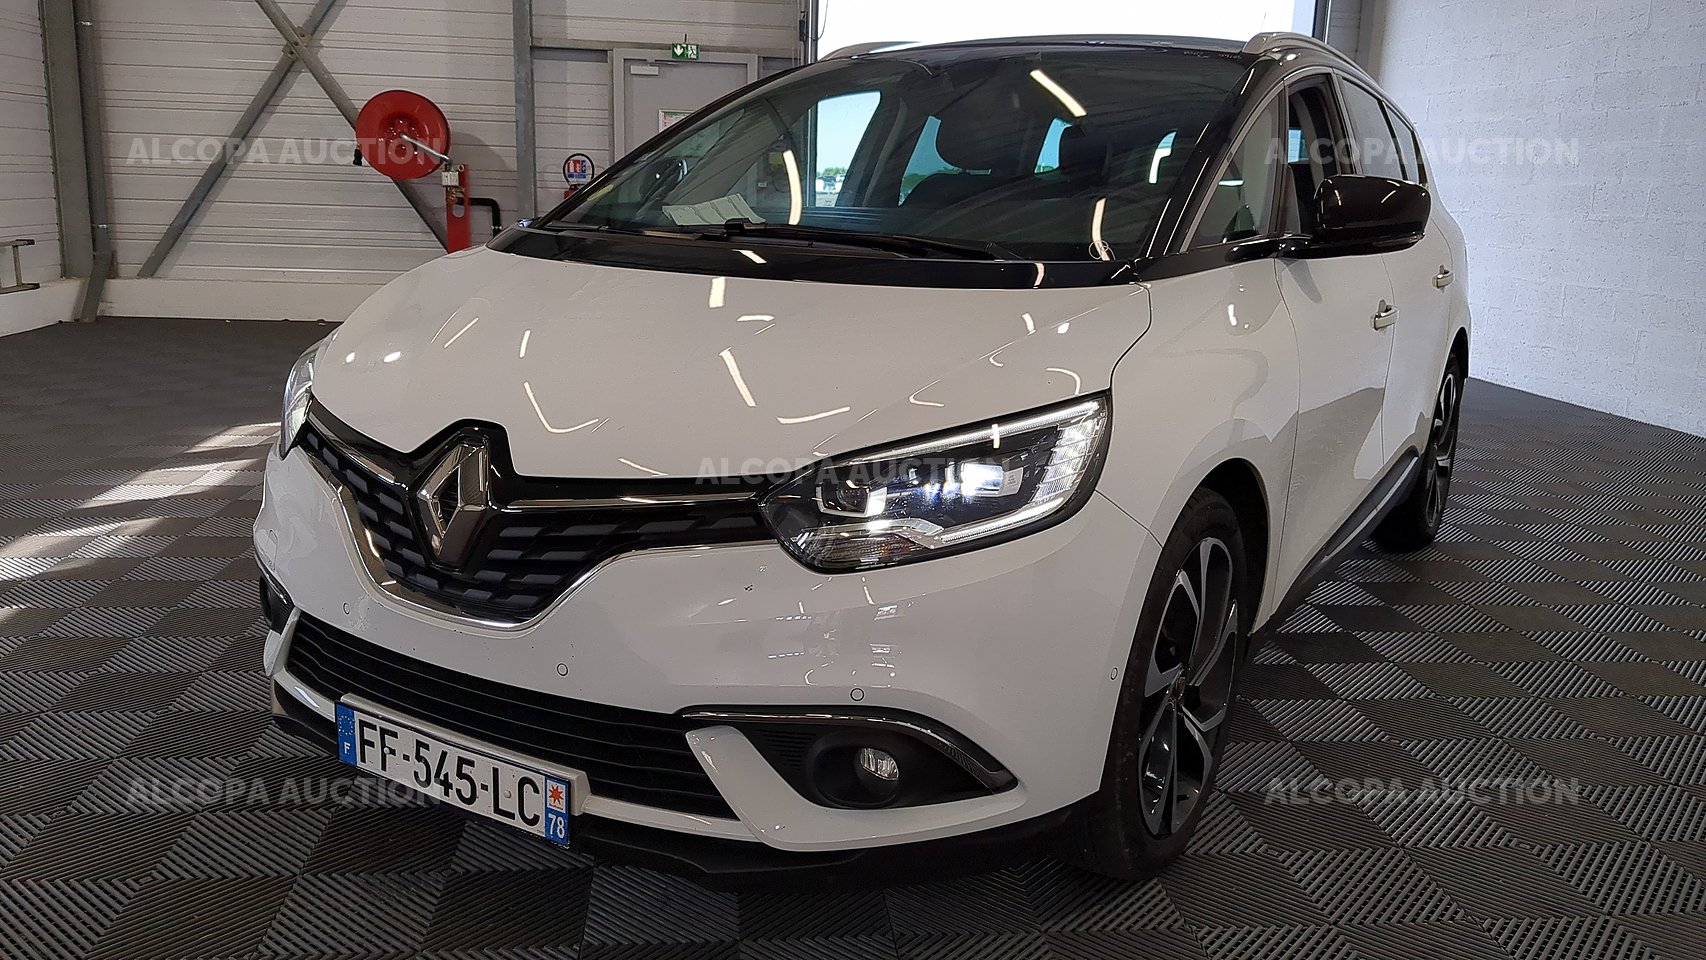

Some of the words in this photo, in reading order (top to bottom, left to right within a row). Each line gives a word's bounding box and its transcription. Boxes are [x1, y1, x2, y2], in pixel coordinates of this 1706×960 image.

[343, 741, 351, 754] F
[357, 718, 541, 828] FF-545-LC
[548, 812, 565, 839] 78
